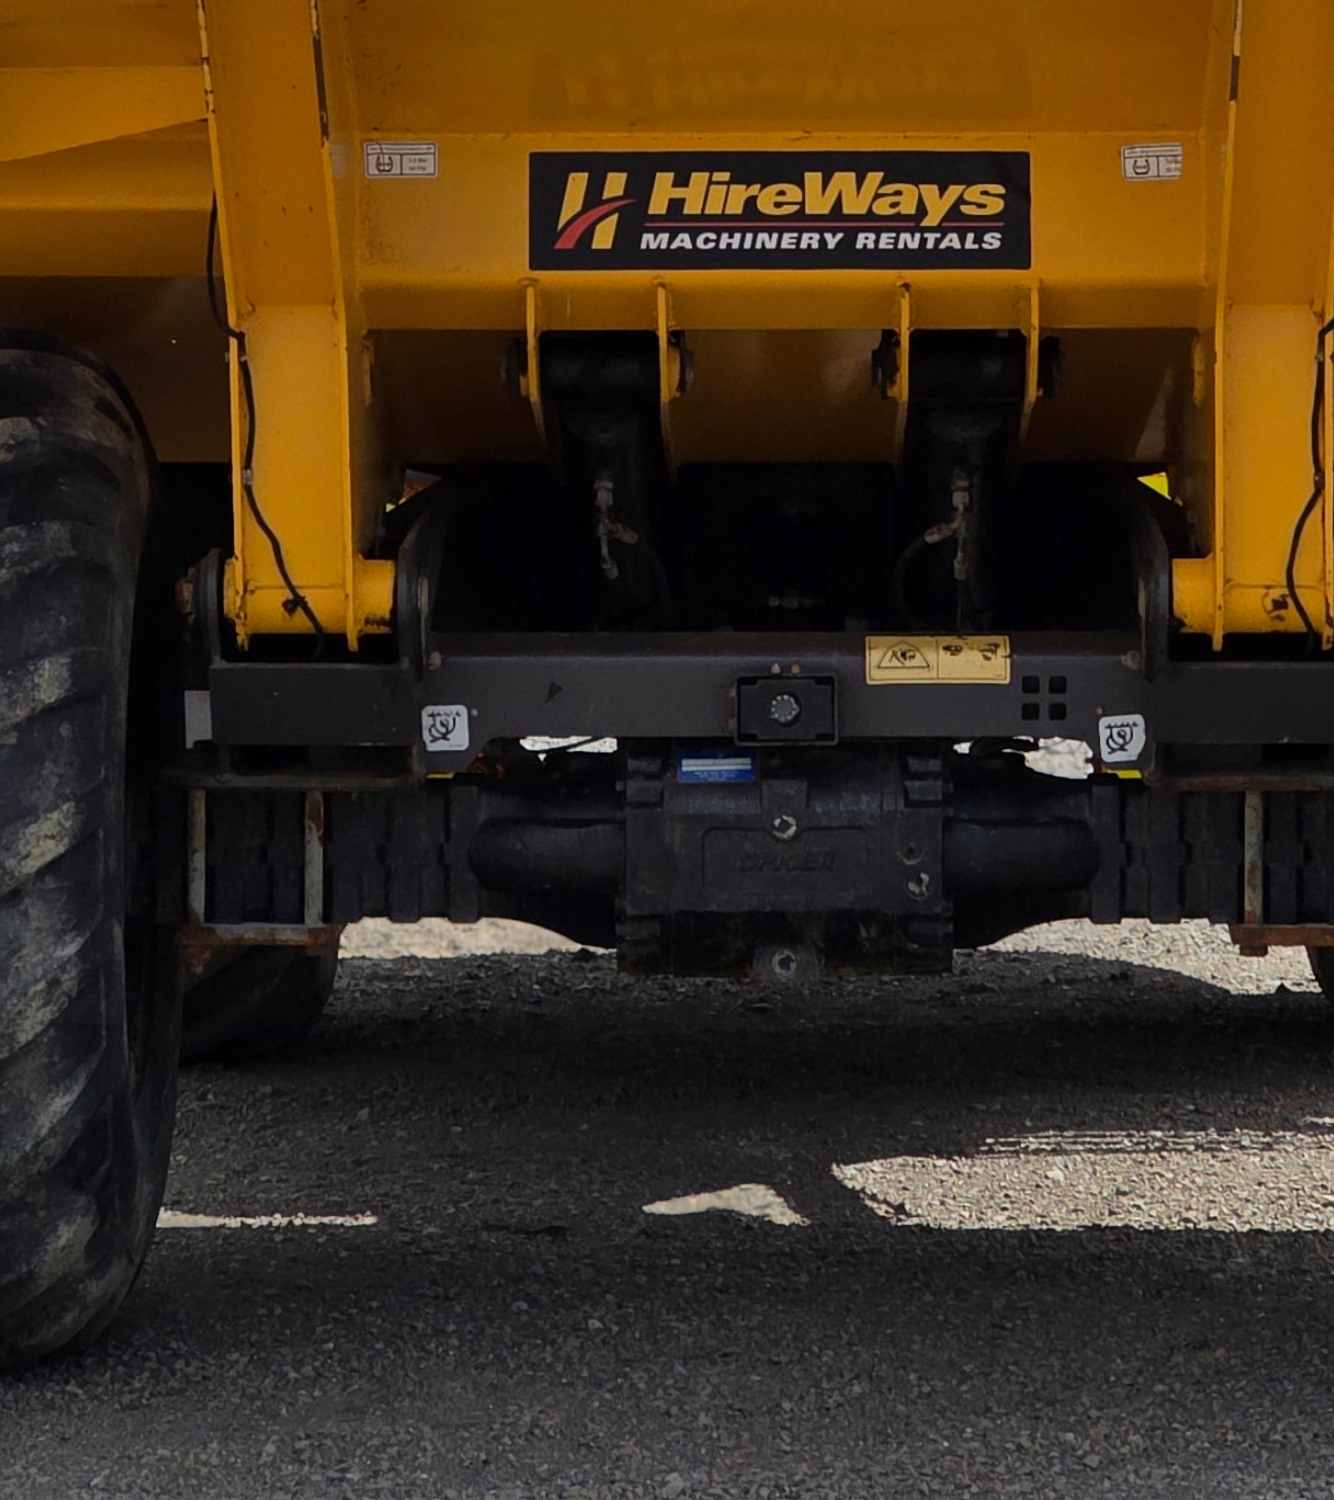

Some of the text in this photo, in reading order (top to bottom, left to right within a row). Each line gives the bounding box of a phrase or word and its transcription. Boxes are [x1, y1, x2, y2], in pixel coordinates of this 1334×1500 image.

[647, 171, 1007, 227] HireWays
[639, 231, 1003, 250] MACHINERY RENTALS
